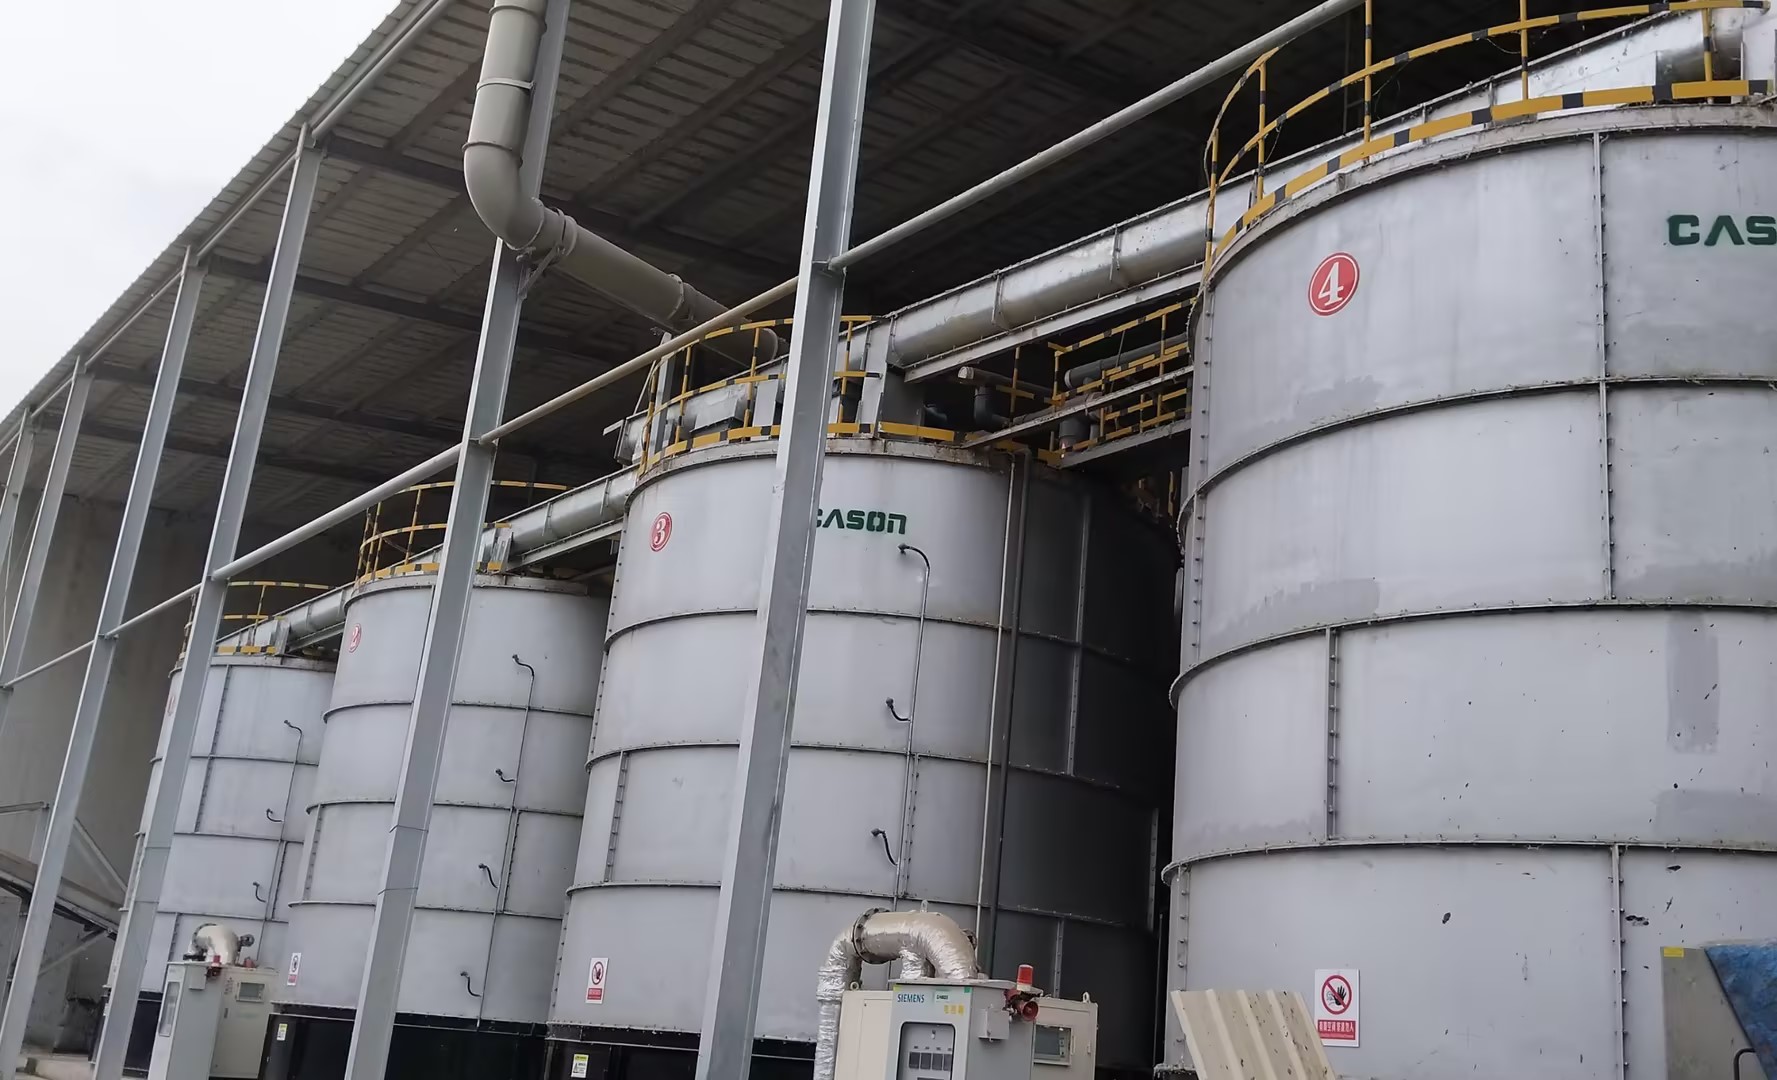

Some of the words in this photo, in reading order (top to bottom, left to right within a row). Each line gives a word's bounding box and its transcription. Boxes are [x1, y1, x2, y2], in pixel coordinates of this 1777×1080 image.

[1318, 261, 1344, 306] 4
[653, 518, 667, 546] 3
[897, 993, 925, 1004] SIEMENS
